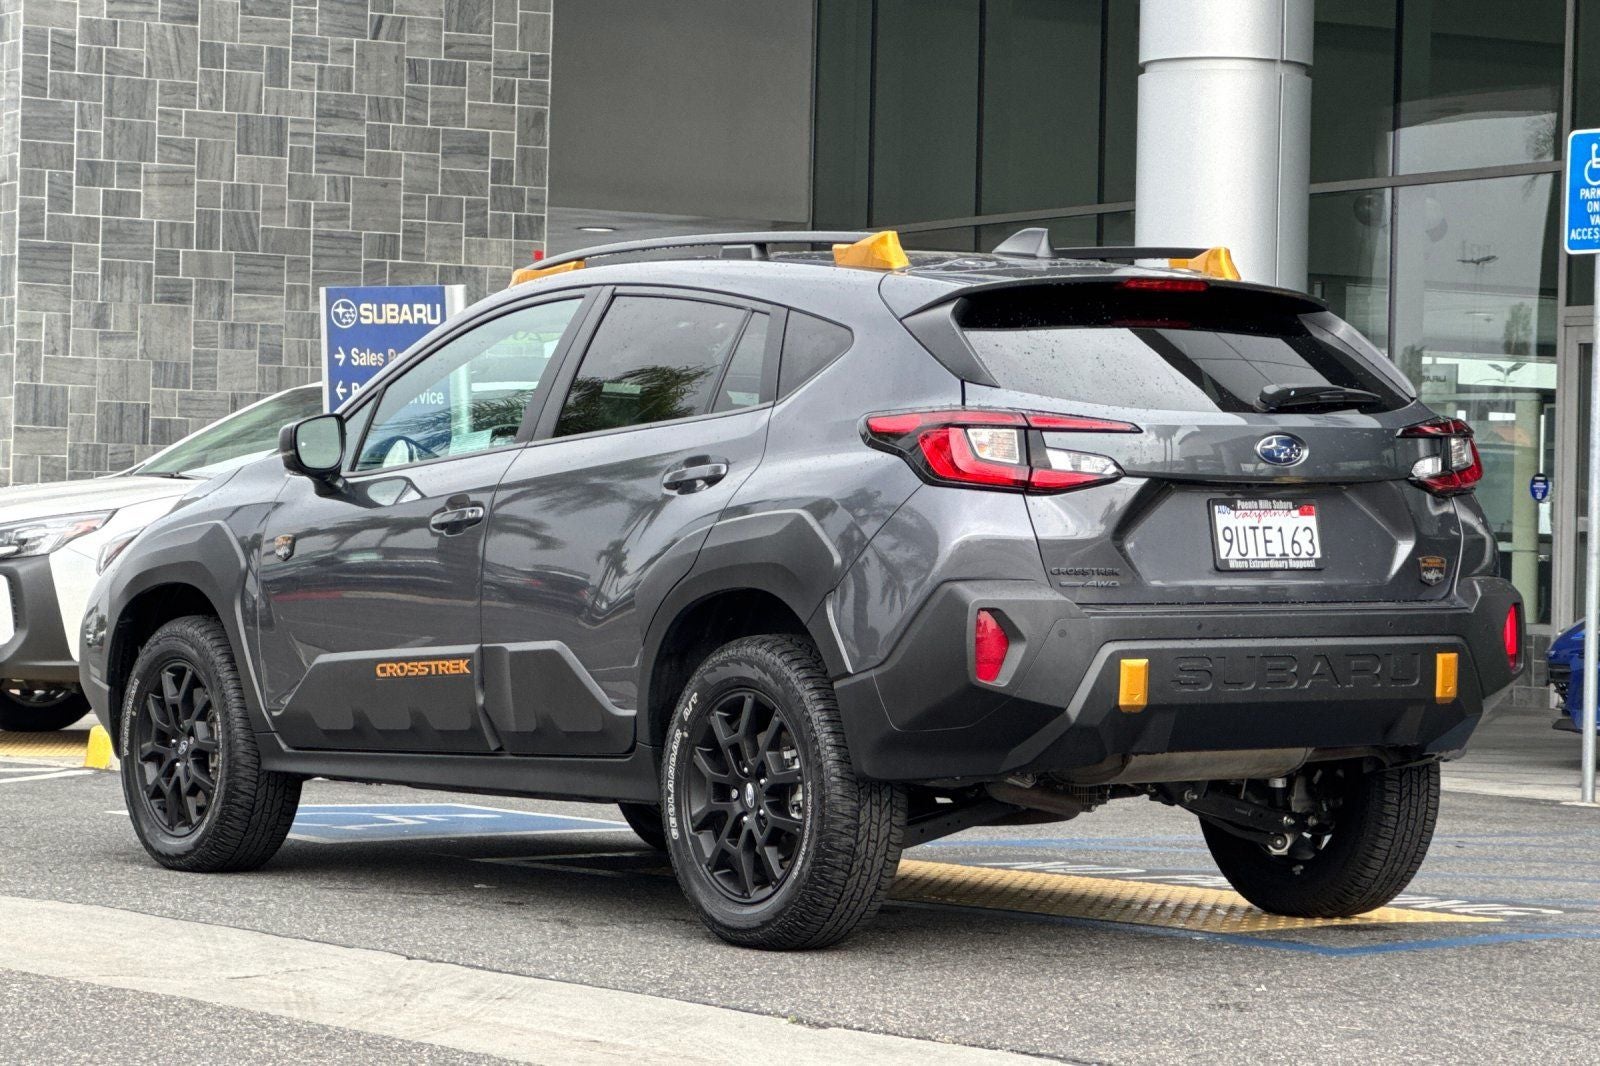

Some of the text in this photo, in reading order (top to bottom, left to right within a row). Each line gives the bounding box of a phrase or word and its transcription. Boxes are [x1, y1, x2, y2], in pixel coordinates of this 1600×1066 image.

[359, 303, 441, 325] SUBARU
[351, 347, 385, 367] Sales
[1237, 500, 1258, 510] Puente
[1259, 500, 1272, 510] Hills
[1272, 500, 1294, 510] Subaru
[1222, 526, 1316, 557] 9UTE163
[1050, 567, 1120, 577] CROSSTREK
[1228, 559, 1249, 569] Where
[1249, 558, 1288, 569] Extraordinary
[1084, 580, 1120, 588] AWD
[375, 659, 471, 677] CROSSTREK
[1170, 653, 1421, 692] SUBARU
